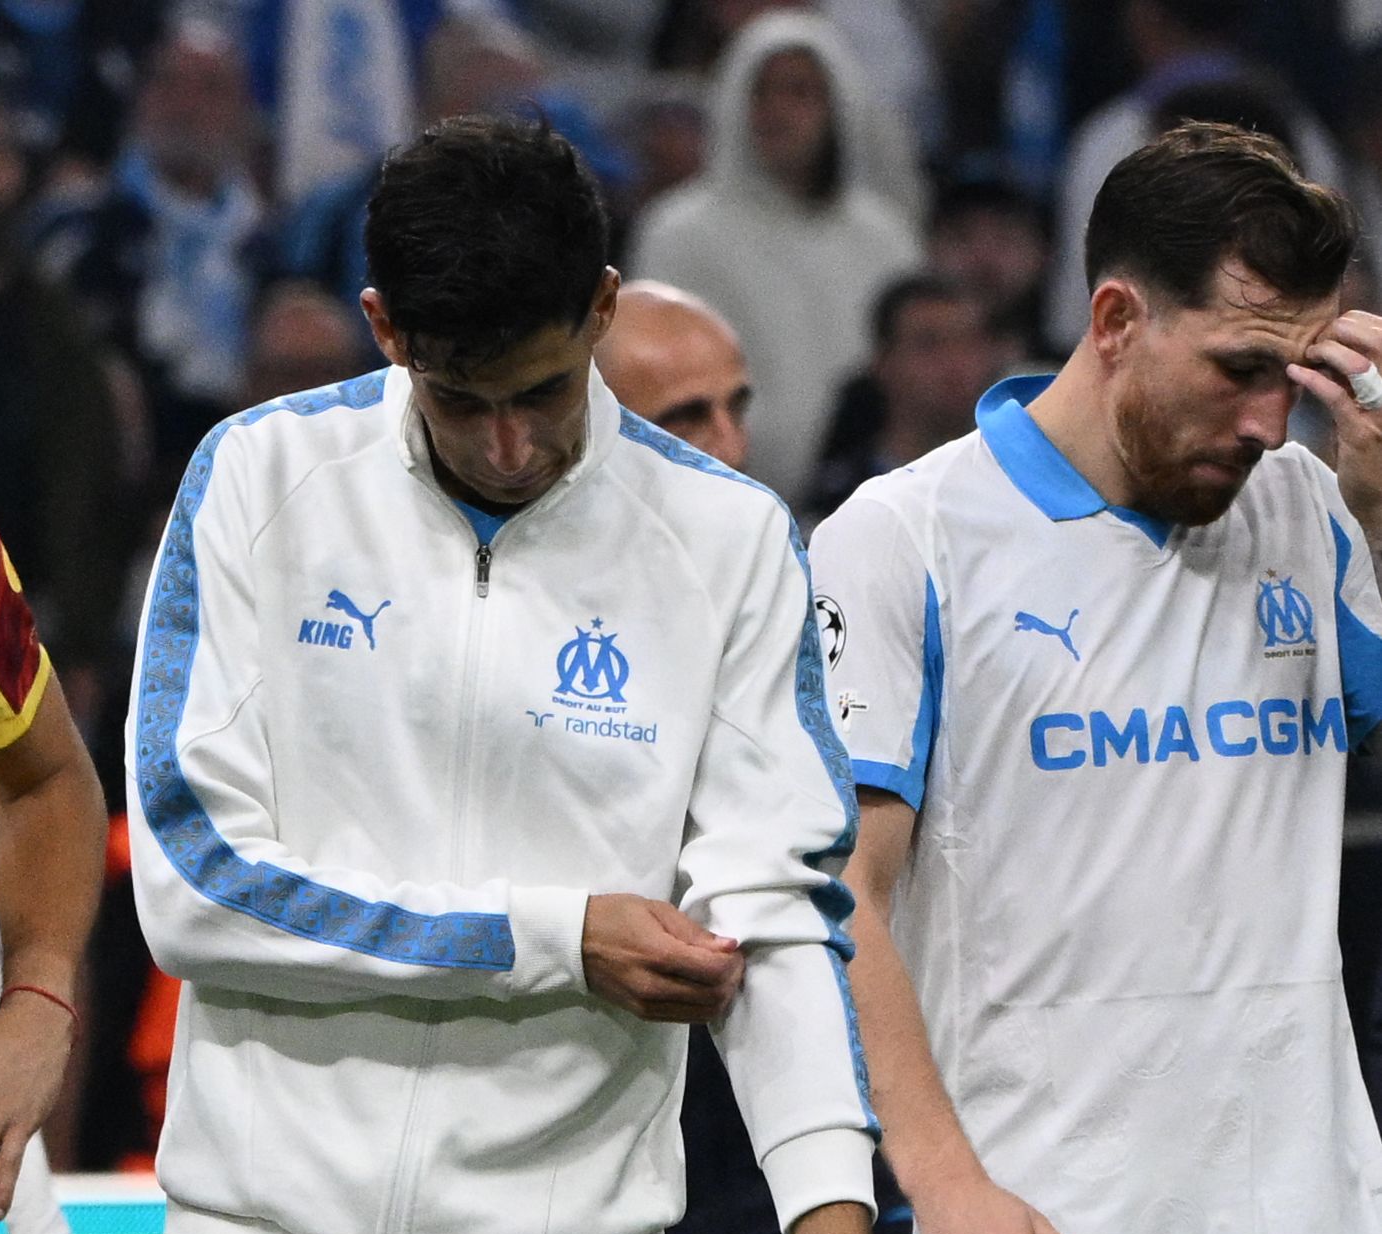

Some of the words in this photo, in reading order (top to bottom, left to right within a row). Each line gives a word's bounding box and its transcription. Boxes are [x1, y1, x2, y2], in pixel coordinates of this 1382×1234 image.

[297, 619, 354, 650] KING
[552, 696, 583, 710] DROIT
[586, 704, 602, 712] AU
[604, 706, 628, 714] BUT
[565, 717, 658, 743] randstad
[1030, 706, 1200, 771] CMA
[1206, 696, 1348, 758] CGM
